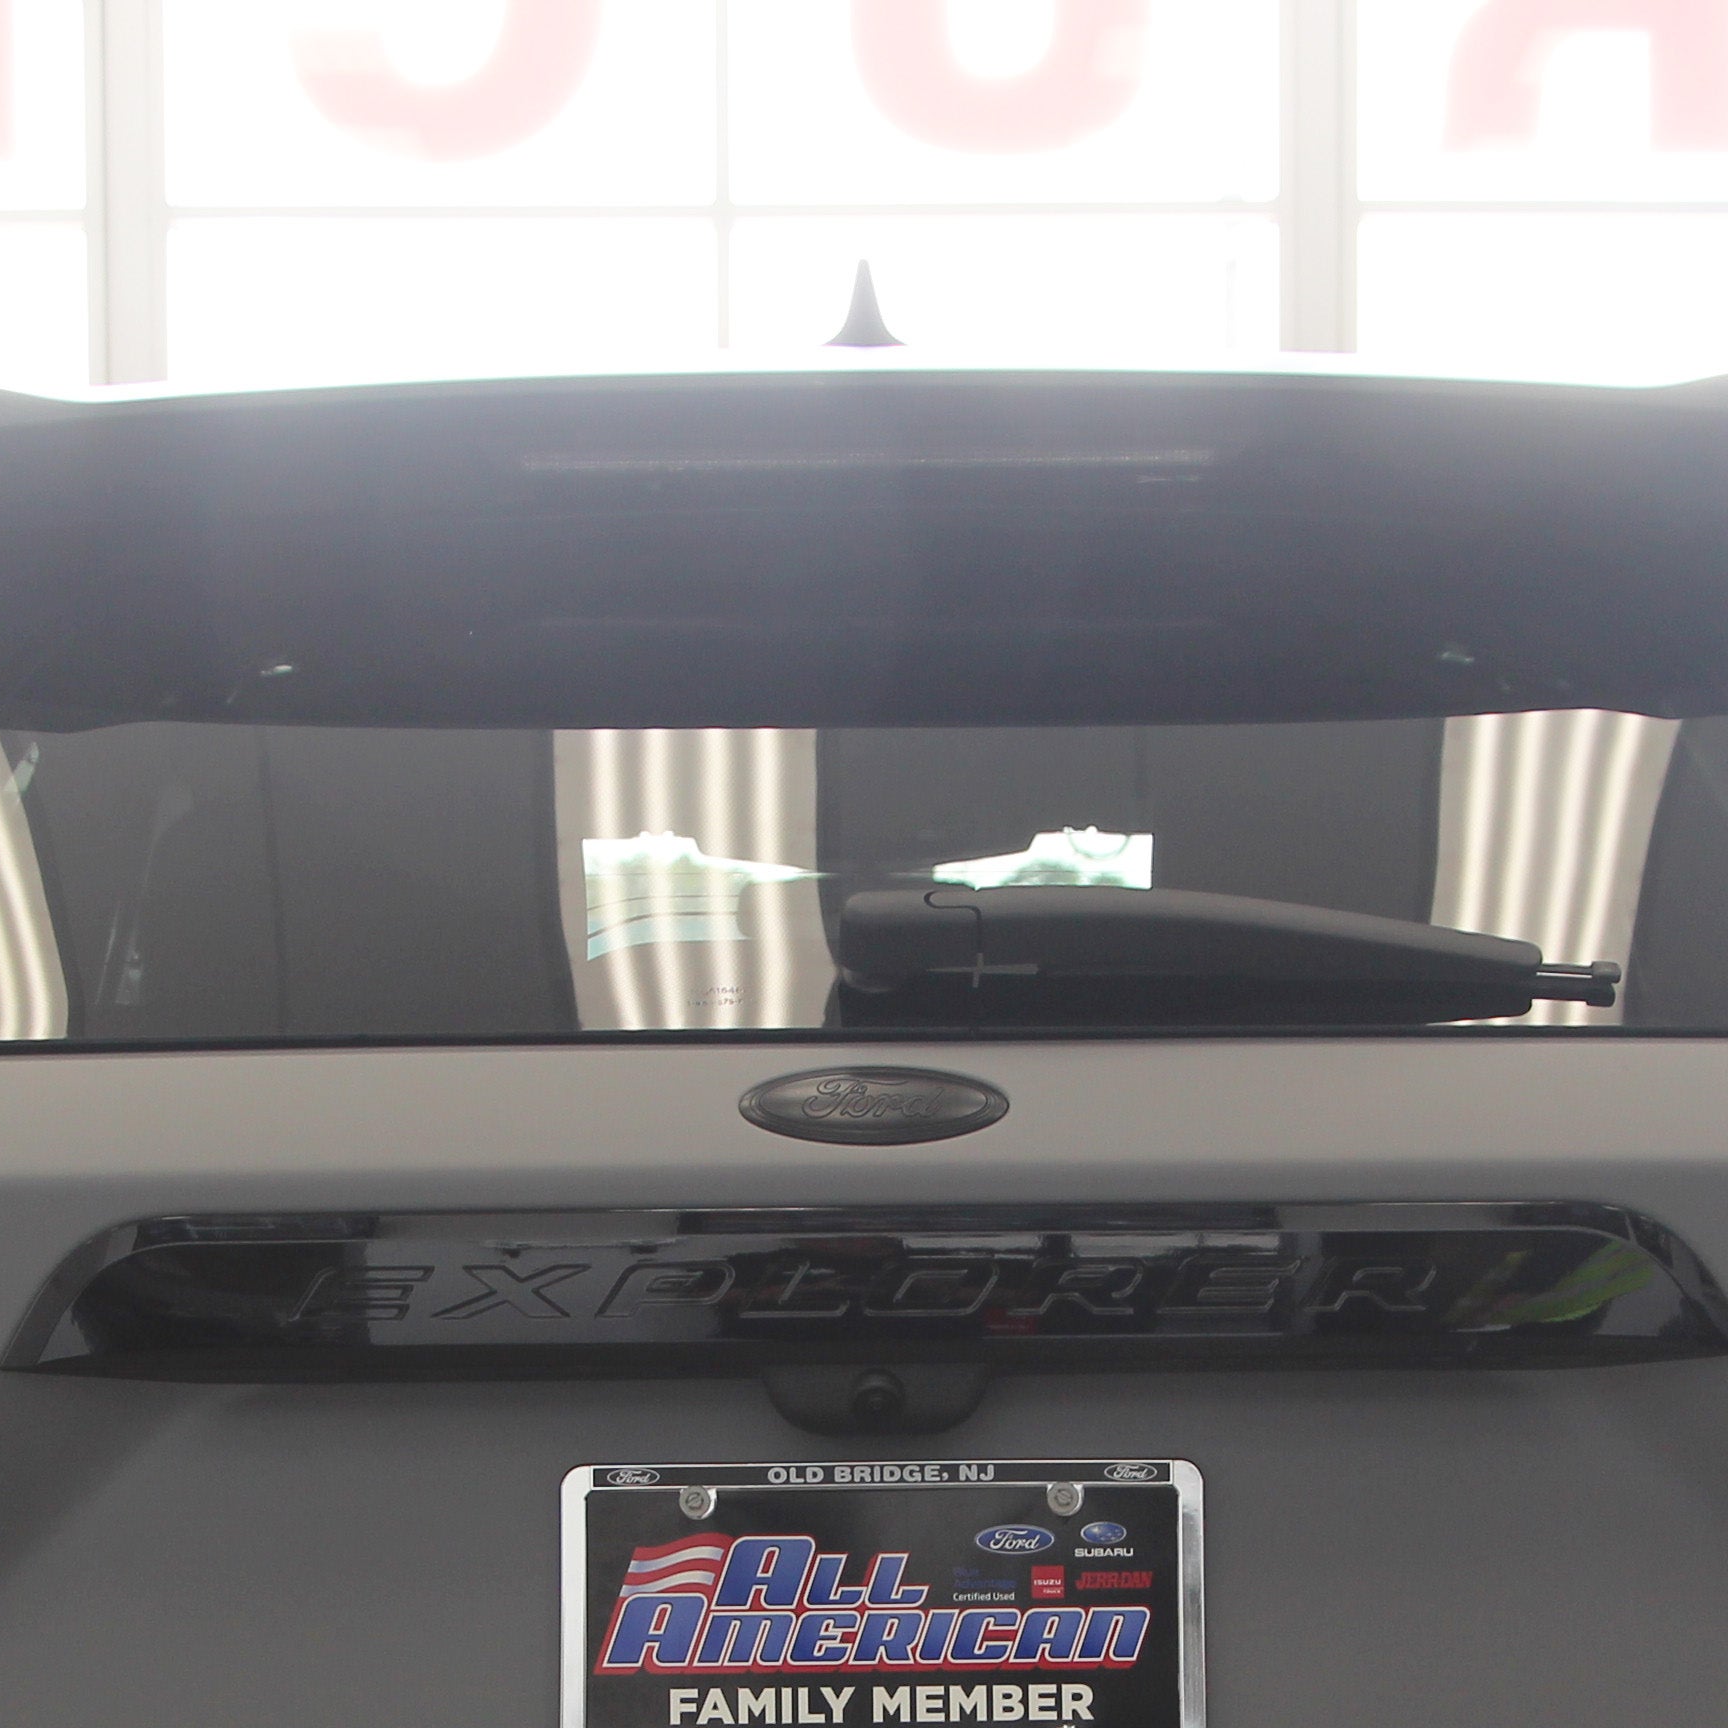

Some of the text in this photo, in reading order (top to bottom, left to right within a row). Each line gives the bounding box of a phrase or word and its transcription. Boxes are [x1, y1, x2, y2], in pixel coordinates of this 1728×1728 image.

[801, 1078, 946, 1119] Ford
[284, 1256, 1437, 1324] EXPLORER
[615, 1469, 650, 1484] Ford
[767, 1463, 995, 1484] OLD BRIDGE, NJ
[1112, 1464, 1149, 1480] Ford
[989, 1529, 1041, 1550] Ford
[1074, 1547, 1134, 1558] SUBARU
[1033, 1578, 1062, 1586] ISUZU
[953, 1591, 1015, 1601] Certified Used
[669, 1683, 1095, 1726] FAMILY MEMBER
